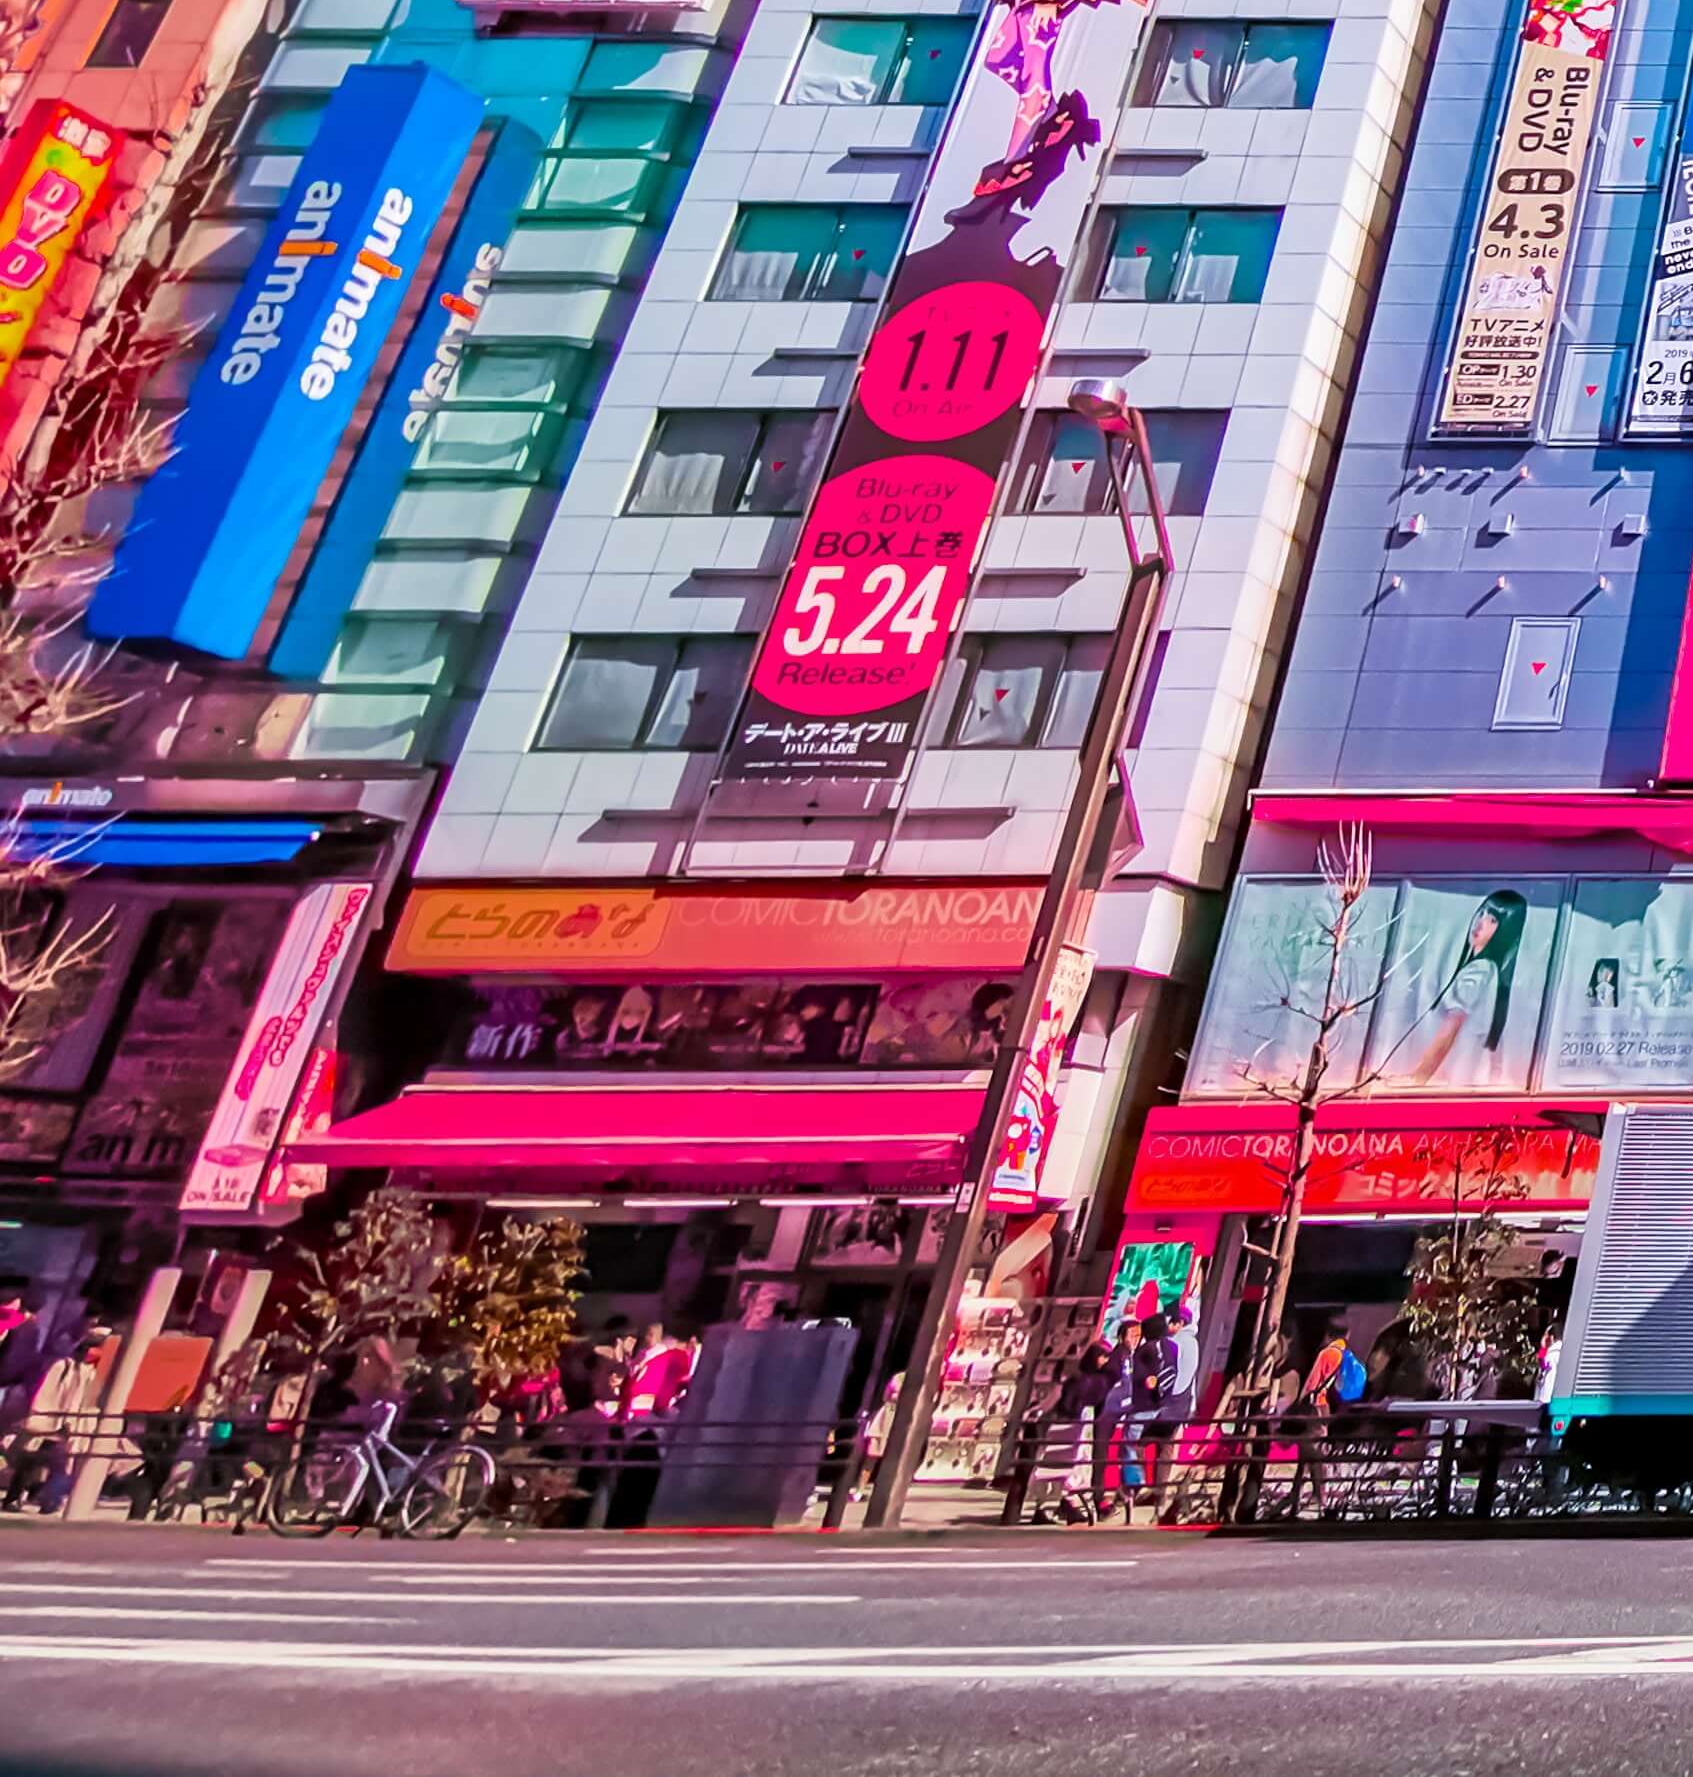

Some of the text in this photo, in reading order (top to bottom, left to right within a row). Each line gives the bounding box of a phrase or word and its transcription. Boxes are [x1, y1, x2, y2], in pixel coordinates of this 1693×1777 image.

[1519, 67, 1554, 152] & DVD
[1544, 67, 1590, 156] Blu-ray
[1484, 244, 1560, 258] On Sale
[1488, 203, 1565, 240] 4.3
[222, 180, 343, 386] animate
[300, 187, 413, 402] animate
[1471, 318, 1545, 332] TVアニメ
[900, 330, 1009, 391] 1.11
[856, 476, 959, 501] Blu-ray
[878, 503, 943, 525] DVD
[783, 563, 947, 656] 5.24
